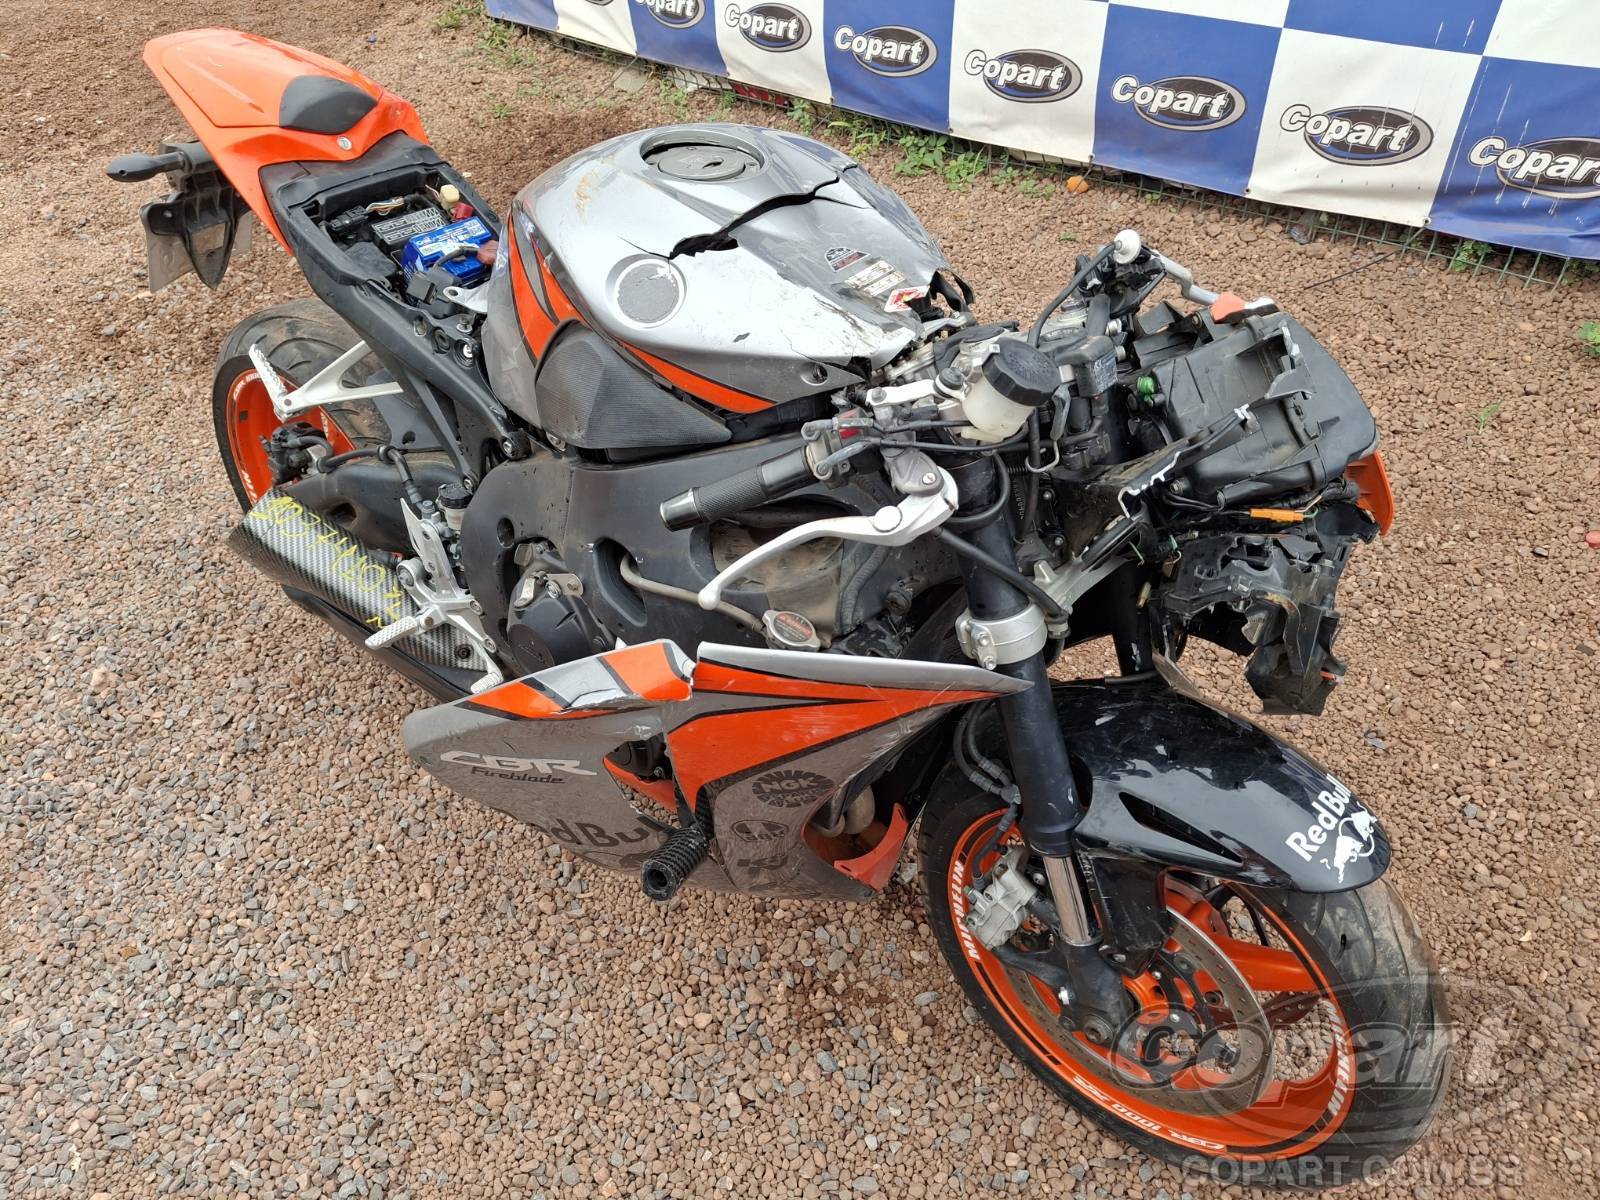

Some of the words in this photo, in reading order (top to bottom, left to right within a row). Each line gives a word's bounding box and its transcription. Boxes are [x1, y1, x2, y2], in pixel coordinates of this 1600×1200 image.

[635, 0, 694, 17] part
[725, 3, 800, 41] Copart
[834, 25, 926, 65] Copart
[964, 50, 1067, 92] Copart
[1112, 75, 1230, 119] Copart
[1280, 104, 1413, 152] Copart
[1468, 136, 1600, 187] Copar
[440, 750, 597, 776] CBR
[472, 766, 566, 784] Fireblade
[761, 776, 818, 793] NGK
[1285, 773, 1352, 862] RedBull
[952, 860, 981, 961] MICHELIN
[1318, 998, 1350, 1116] MICHELIN
